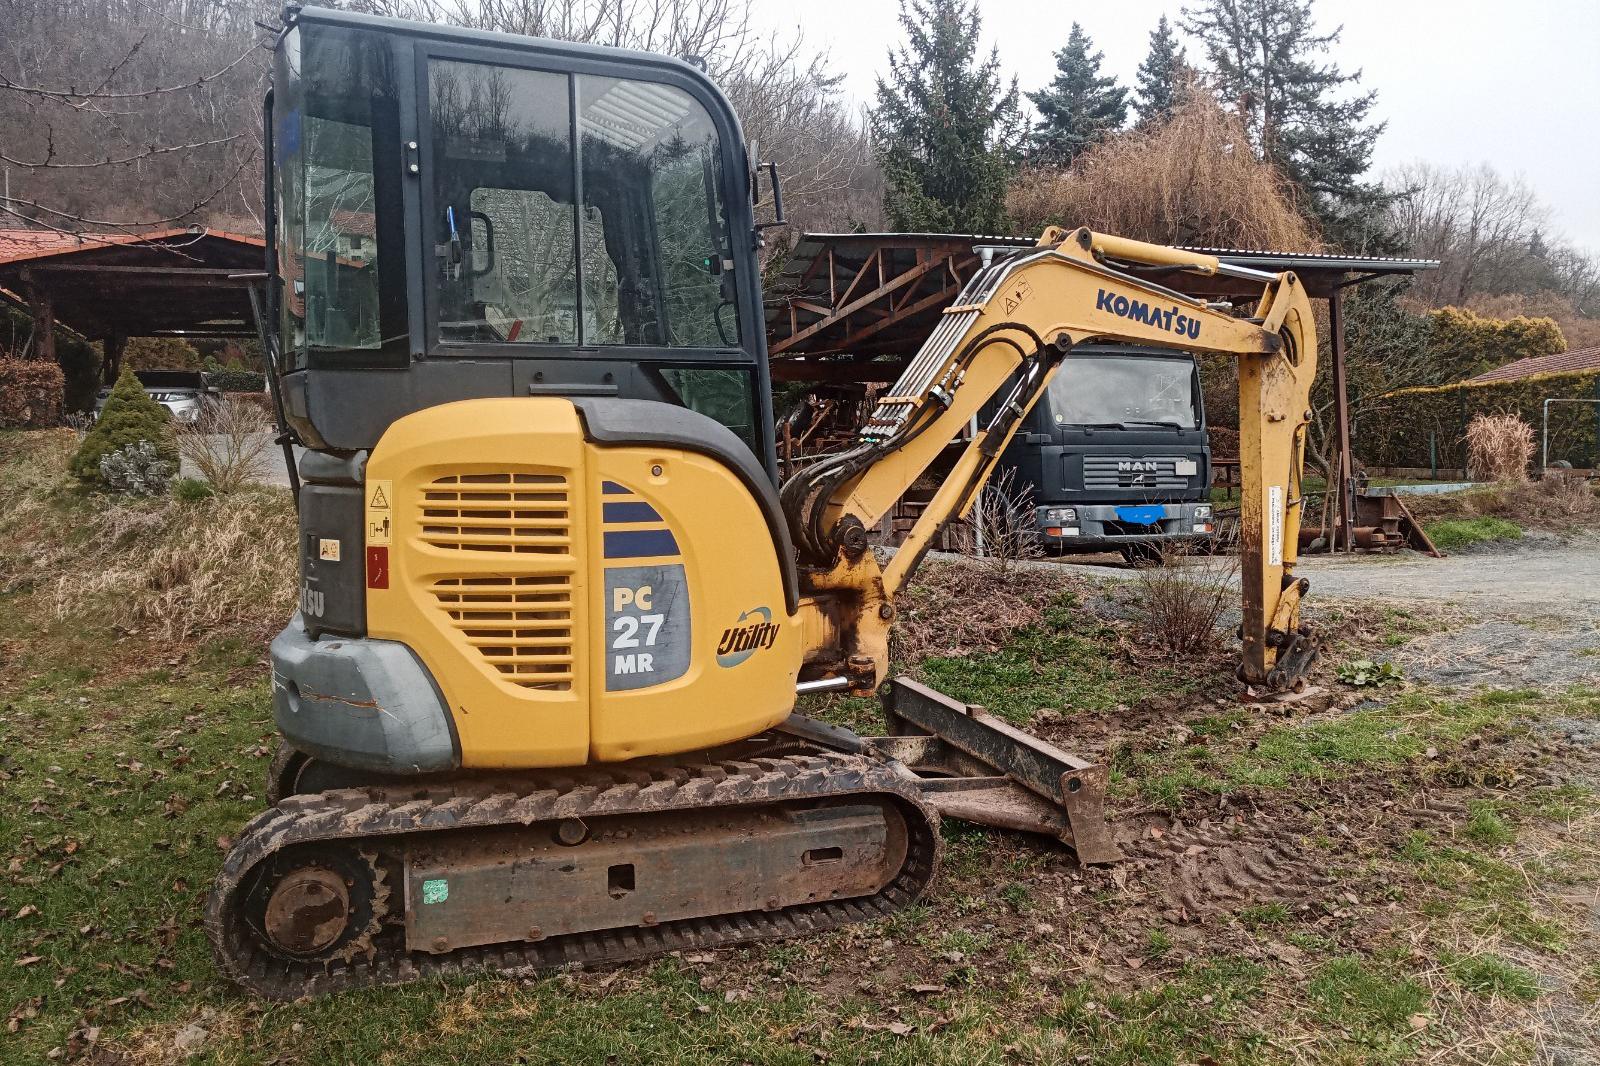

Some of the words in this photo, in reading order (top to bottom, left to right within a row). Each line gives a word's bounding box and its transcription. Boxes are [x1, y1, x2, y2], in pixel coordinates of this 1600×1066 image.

[1096, 288, 1201, 340] KOMATSU
[1118, 461, 1157, 471] MAN
[301, 580, 325, 618] TSU
[613, 585, 652, 612] PC
[612, 613, 665, 649] 27
[716, 622, 781, 656] Utility
[614, 653, 654, 675] MR
